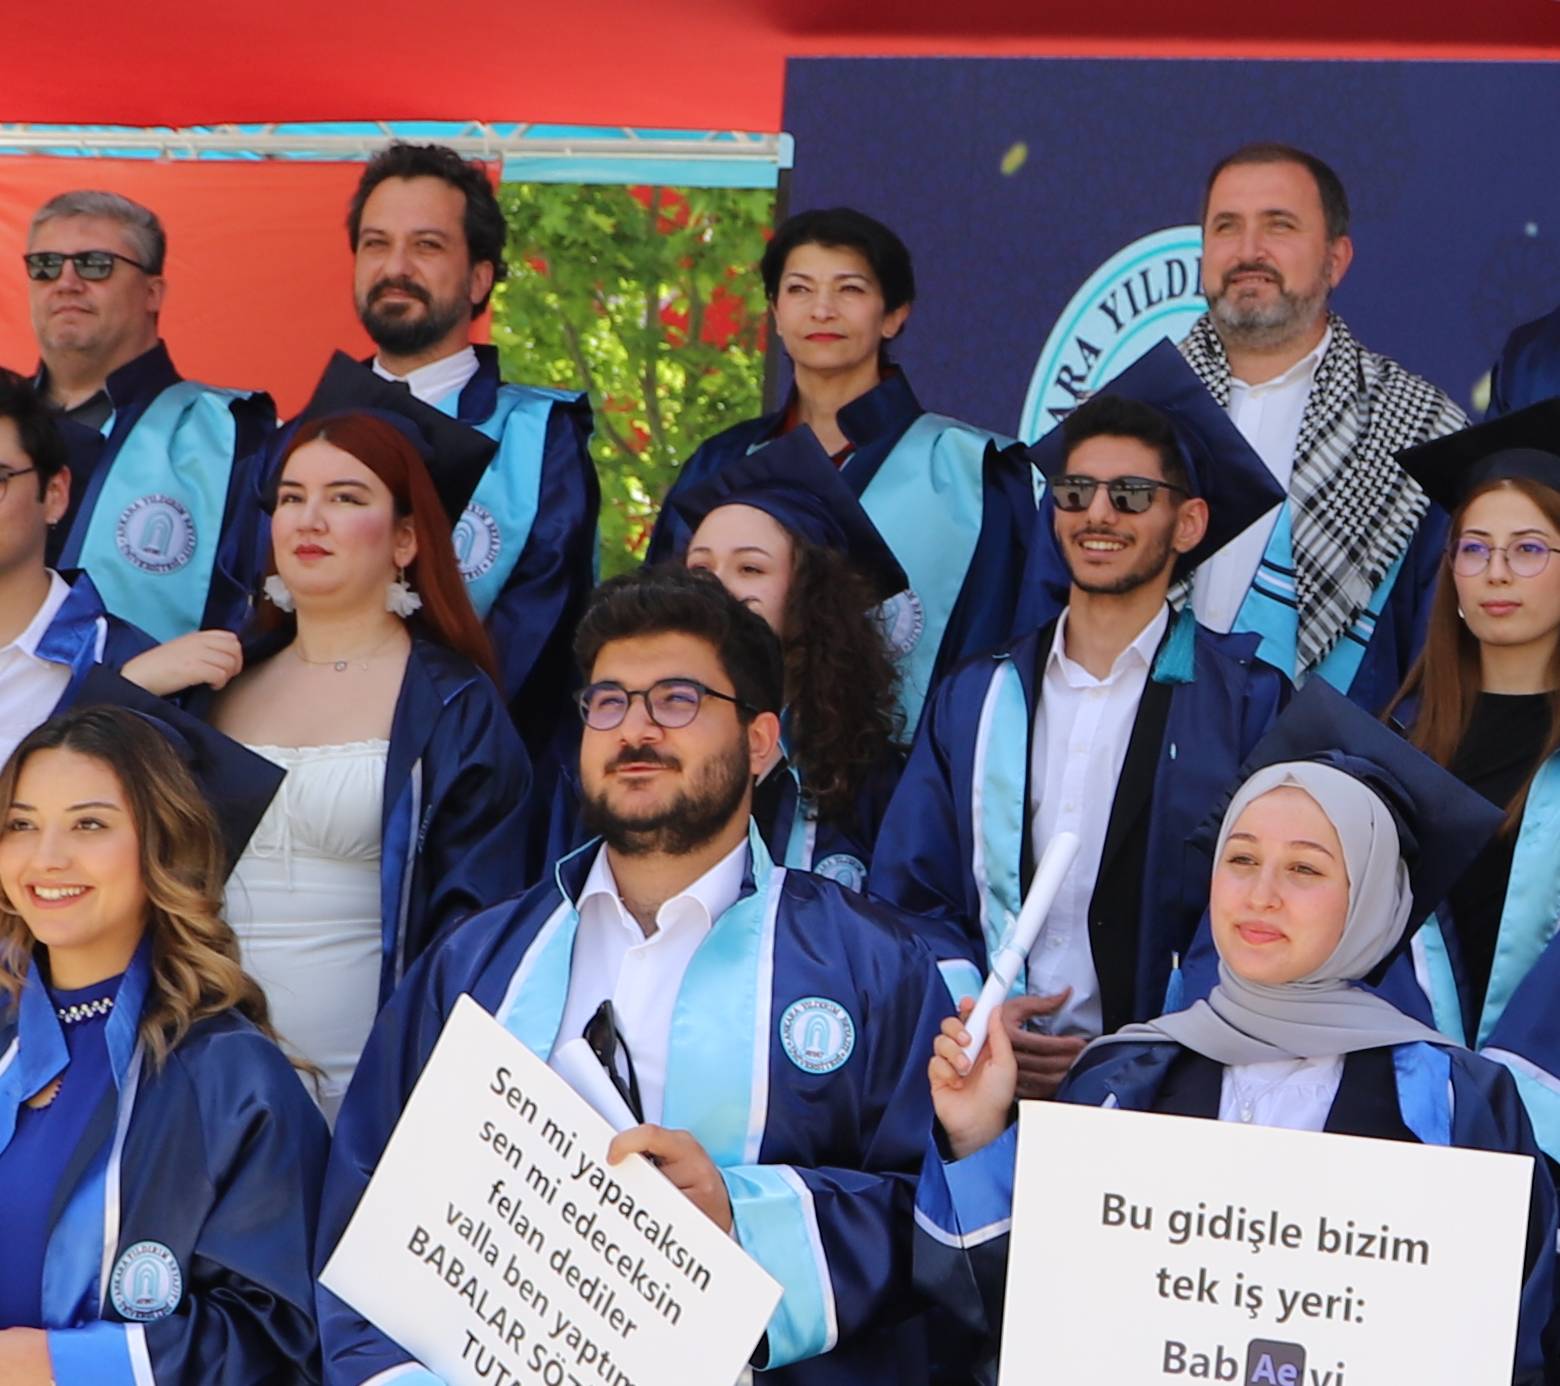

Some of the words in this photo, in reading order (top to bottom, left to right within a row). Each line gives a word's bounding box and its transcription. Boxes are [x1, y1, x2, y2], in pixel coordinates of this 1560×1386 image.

[1097, 256, 1205, 335] YILDI
[479, 1119, 524, 1182] sen
[526, 1165, 562, 1206] mi
[561, 1200, 682, 1326] edeceksin
[488, 1066, 538, 1127] Sen
[539, 1114, 578, 1161] mi
[571, 1150, 712, 1293] yapacaksın
[1101, 1192, 1153, 1230] Bu
[1167, 1203, 1303, 1254] gidişle
[1316, 1217, 1430, 1265] bizim
[406, 1225, 527, 1356] BABALAR
[443, 1203, 499, 1267] valla
[503, 1259, 549, 1316] ben
[487, 1180, 545, 1253] felan
[549, 1244, 638, 1340] dediler
[1155, 1266, 1220, 1304] tek
[1233, 1273, 1264, 1318] iş
[1276, 1286, 1365, 1324] yeri:
